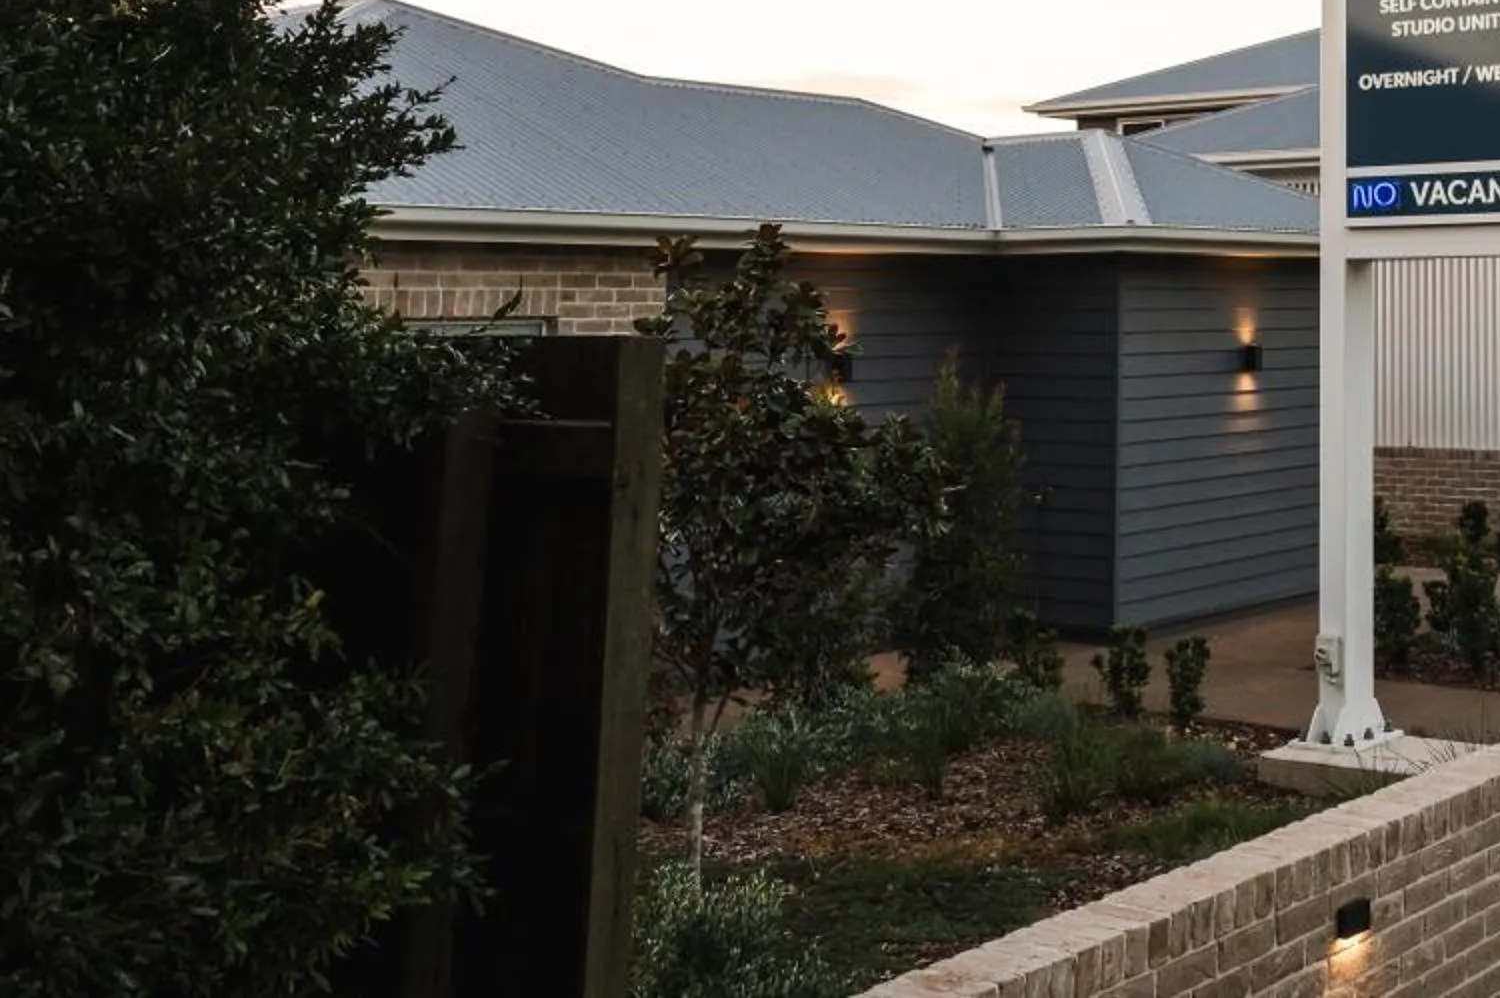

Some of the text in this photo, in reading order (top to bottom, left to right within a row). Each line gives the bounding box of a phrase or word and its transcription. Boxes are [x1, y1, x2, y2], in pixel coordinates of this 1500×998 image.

[1391, 17, 1456, 38] STUDIO
[1358, 67, 1460, 91] OVERNIGHT
[1462, 65, 1473, 85] /
[1353, 181, 1397, 209] NO
